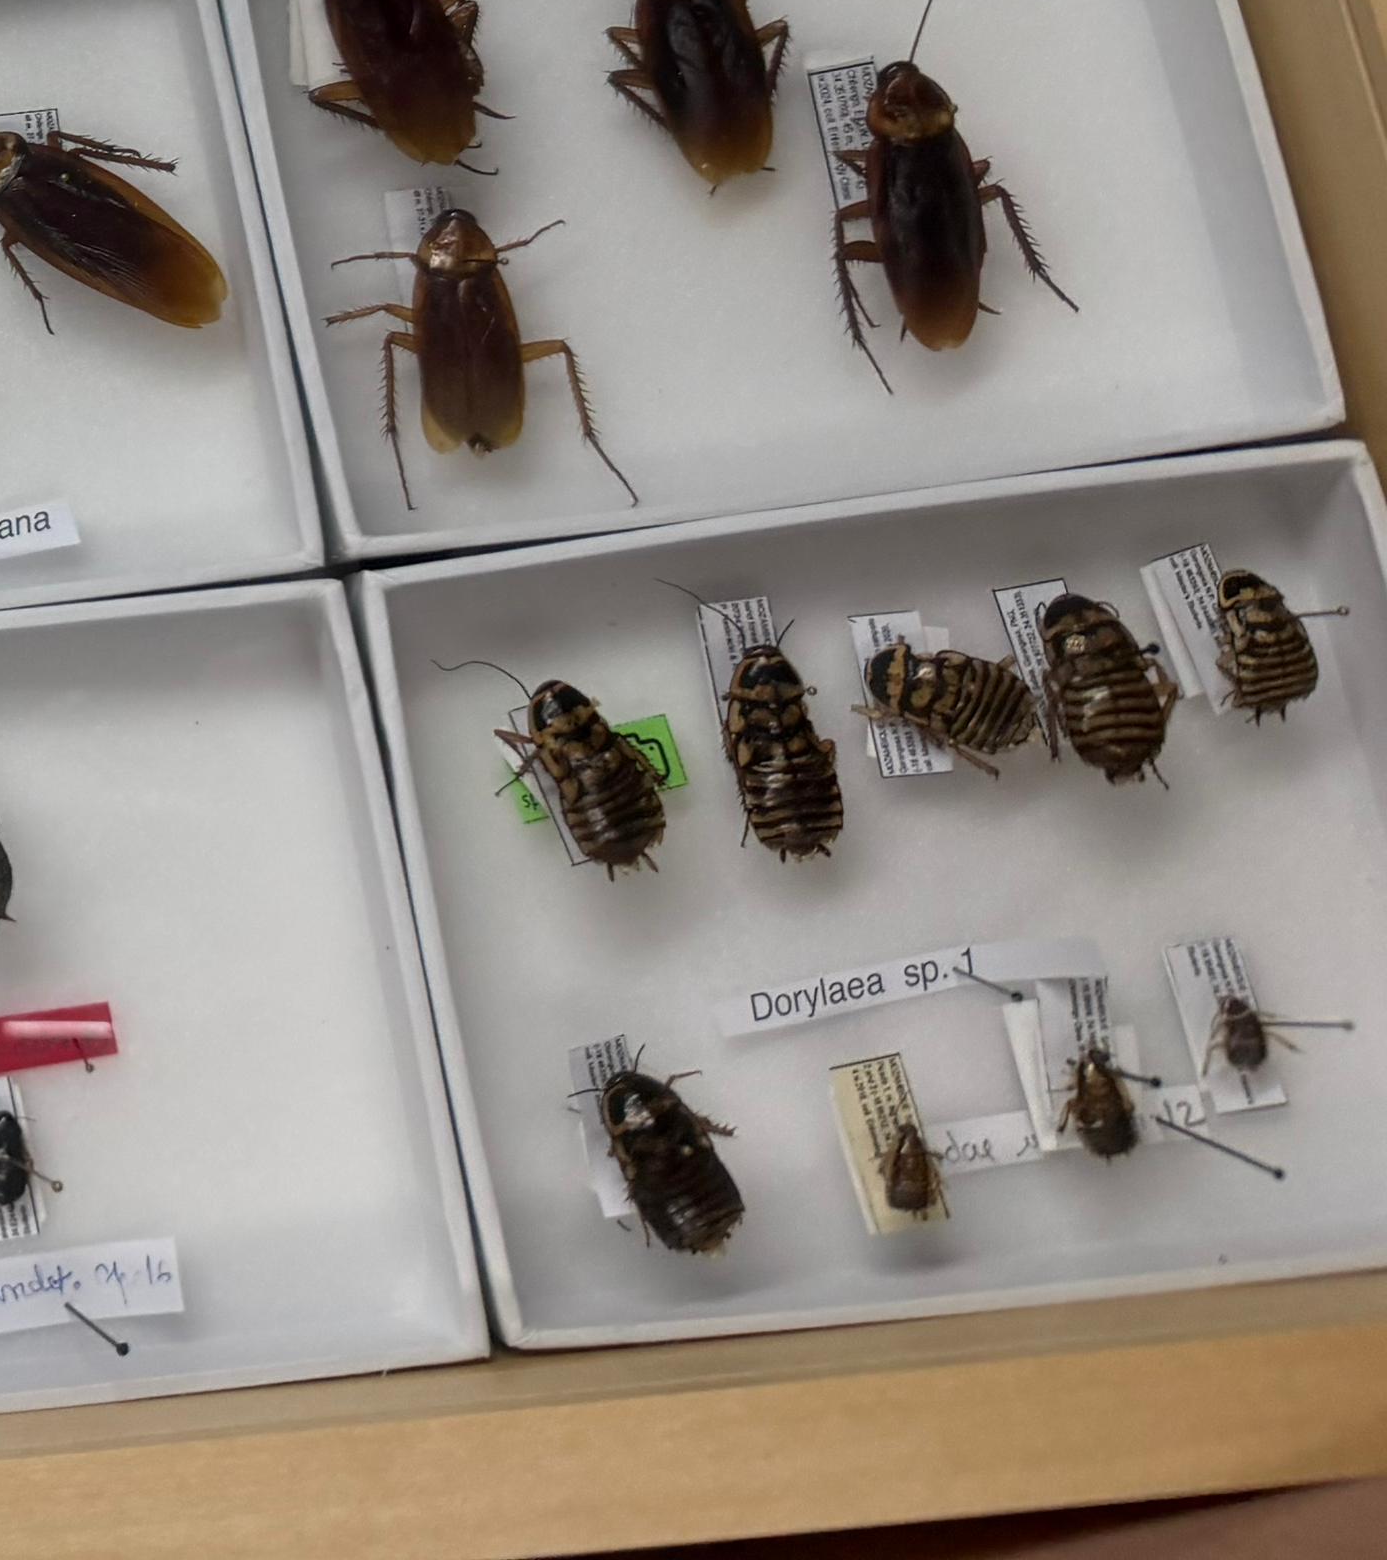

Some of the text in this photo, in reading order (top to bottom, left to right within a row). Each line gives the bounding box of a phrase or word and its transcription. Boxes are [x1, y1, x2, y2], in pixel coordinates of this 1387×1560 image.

[750, 947, 975, 1022] Dorylaea sp. 1
